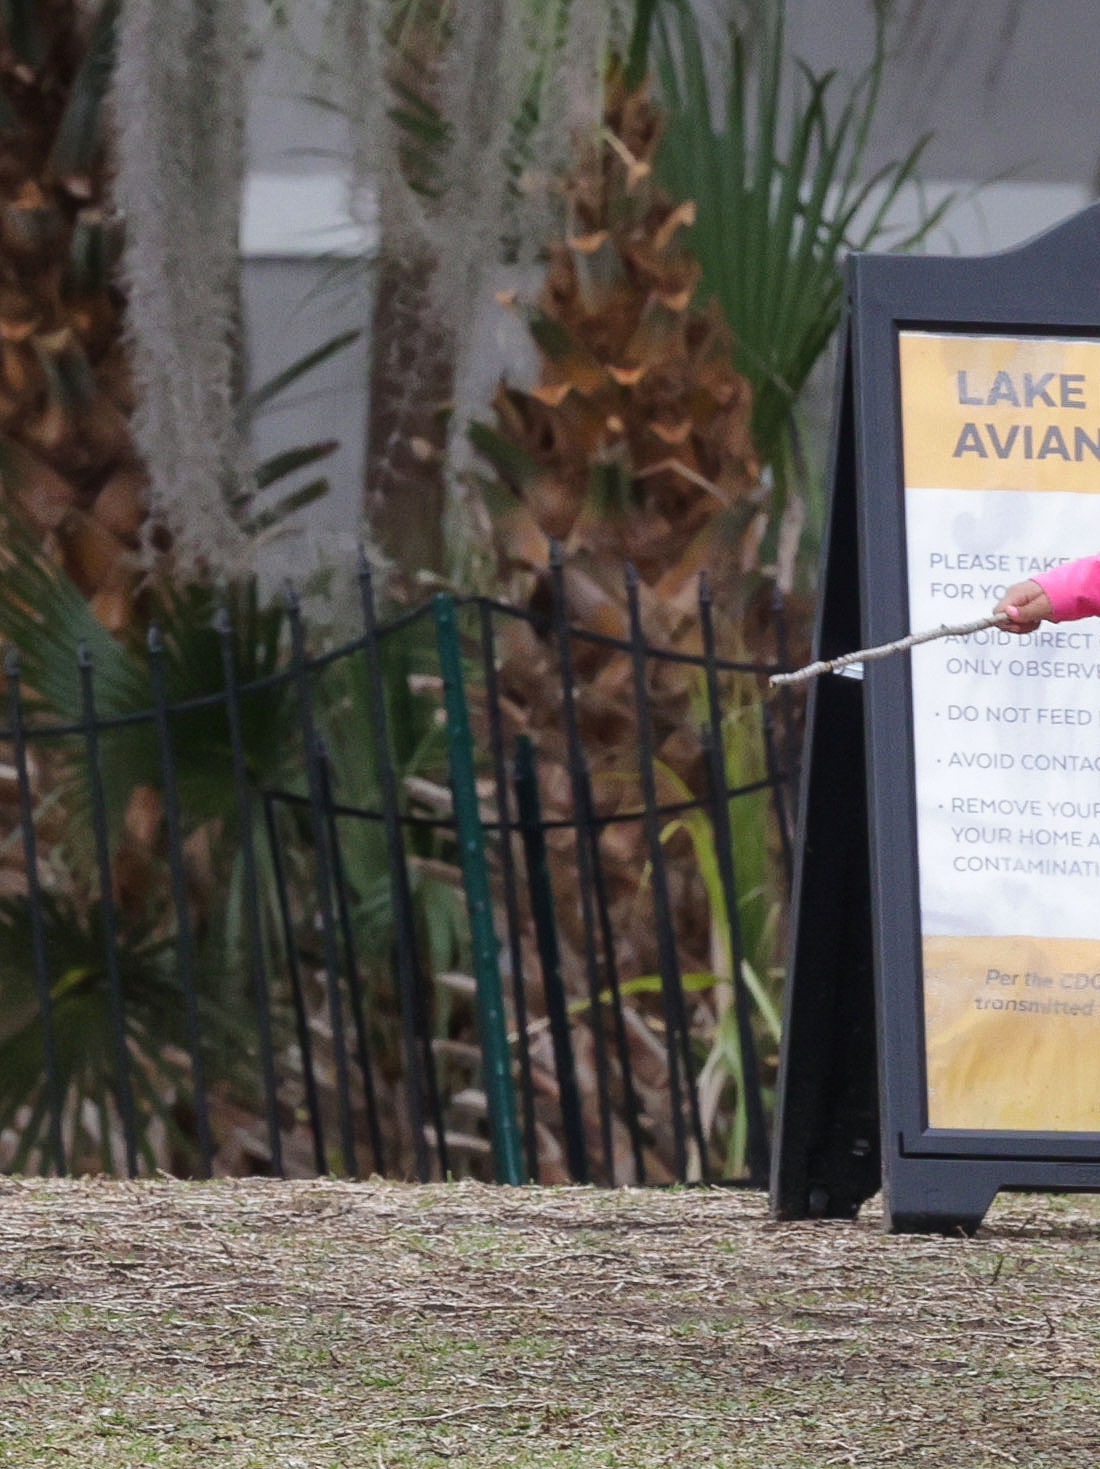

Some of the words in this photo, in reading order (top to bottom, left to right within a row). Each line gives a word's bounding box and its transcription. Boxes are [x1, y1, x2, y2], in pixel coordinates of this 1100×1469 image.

[957, 370, 1086, 409] LAKE
[929, 553, 1010, 571] PLEASE
[1016, 556, 1070, 572] TAK
[931, 582, 974, 599] FOR
[1018, 633, 1092, 649] DIRECT
[946, 658, 1003, 675] ONLY
[948, 705, 979, 723] DO
[986, 707, 1030, 723] NOT
[1037, 709, 1093, 726] FEED
[948, 752, 1015, 770] AVOID
[952, 798, 1043, 816] REMOVE
[952, 827, 1012, 845] YOUR
[1019, 830, 1083, 848] HOME
[985, 969, 1019, 986] Per
